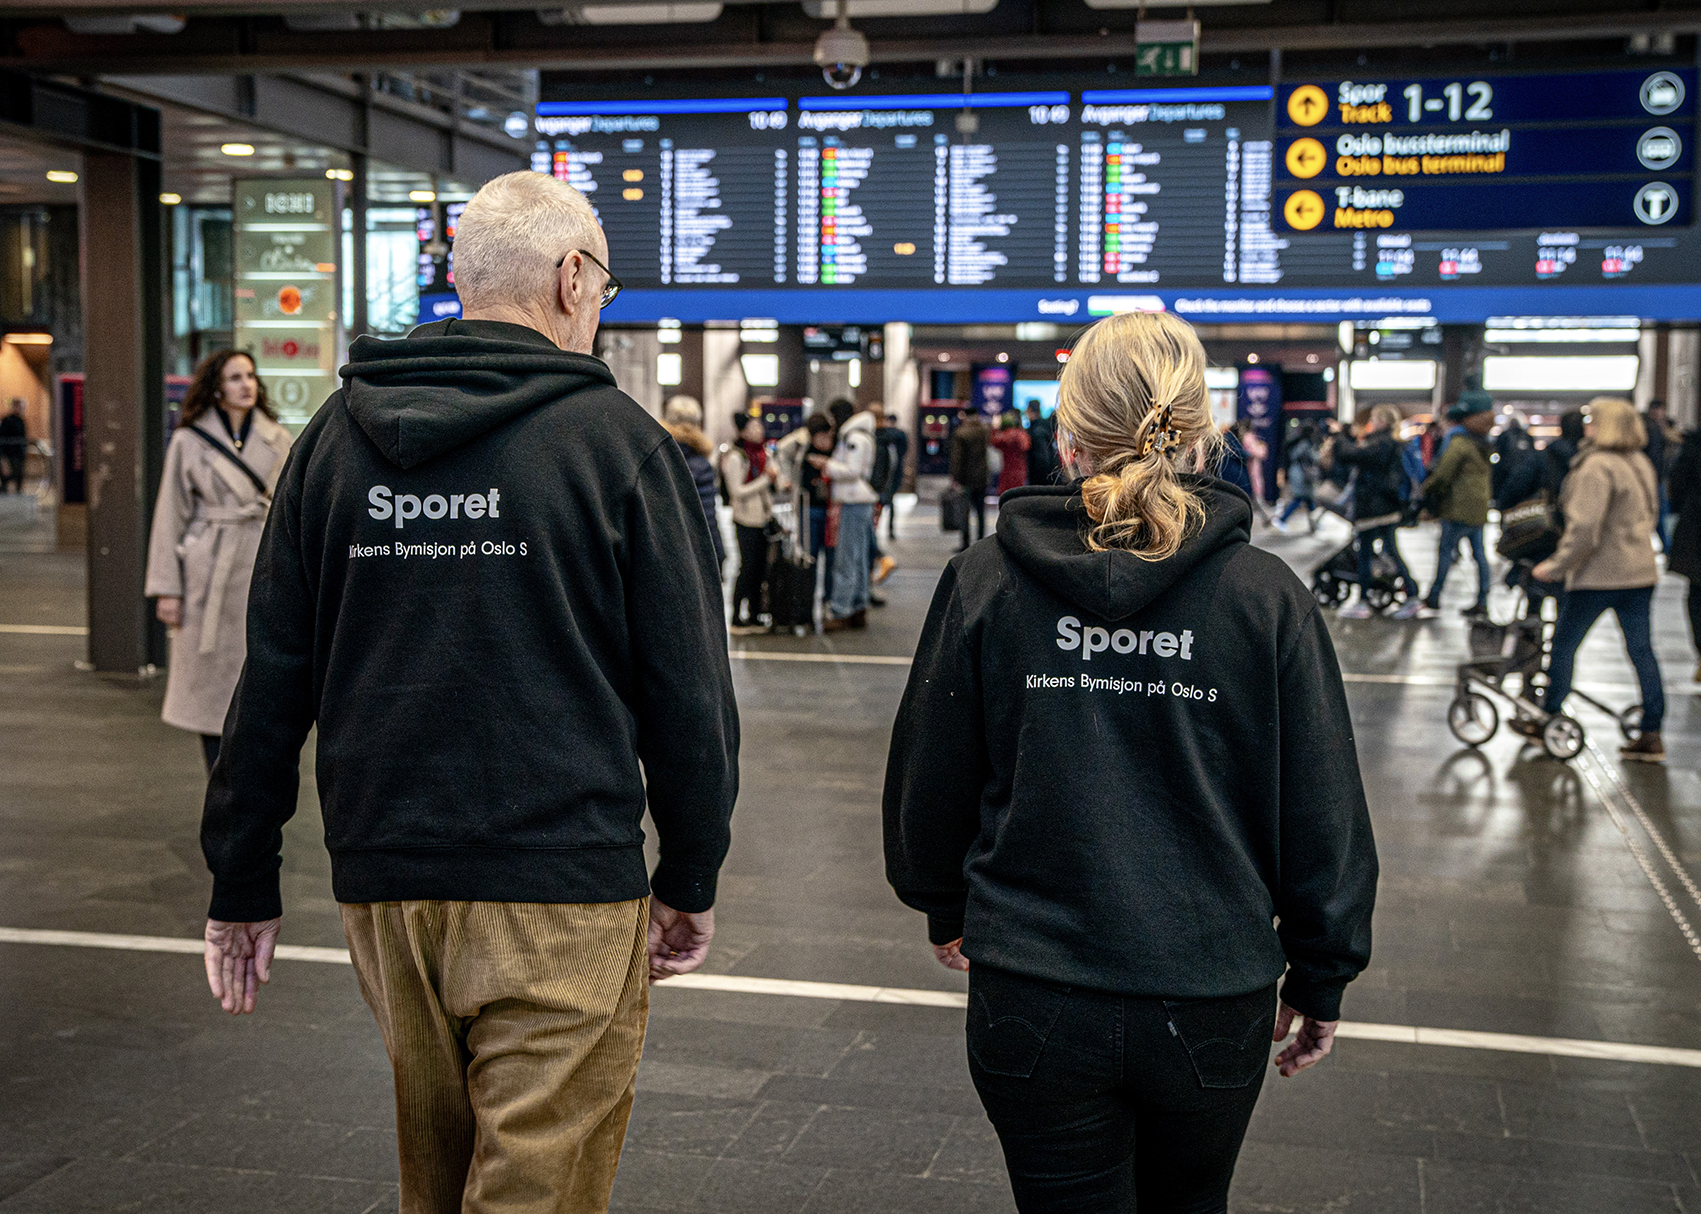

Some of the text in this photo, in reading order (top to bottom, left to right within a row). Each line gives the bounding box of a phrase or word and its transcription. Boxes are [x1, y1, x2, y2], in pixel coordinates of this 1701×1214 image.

[1339, 81, 1387, 106] Spor
[1403, 81, 1493, 122] 1-12
[1338, 102, 1392, 123] Track
[1336, 129, 1510, 156] Oslo bussterminal
[1336, 152, 1505, 176] Oslo bus terminal
[1335, 186, 1404, 208] T-bane
[1334, 207, 1394, 228] Metro
[368, 485, 500, 528] Sporet
[395, 542, 456, 559] Bymisjon
[460, 541, 476, 559] på
[481, 541, 516, 556] Oslo
[519, 542, 528, 556] S
[1056, 616, 1194, 660] Sporet
[1026, 674, 1218, 702] Kirkens Bymisjon på Oslo S
